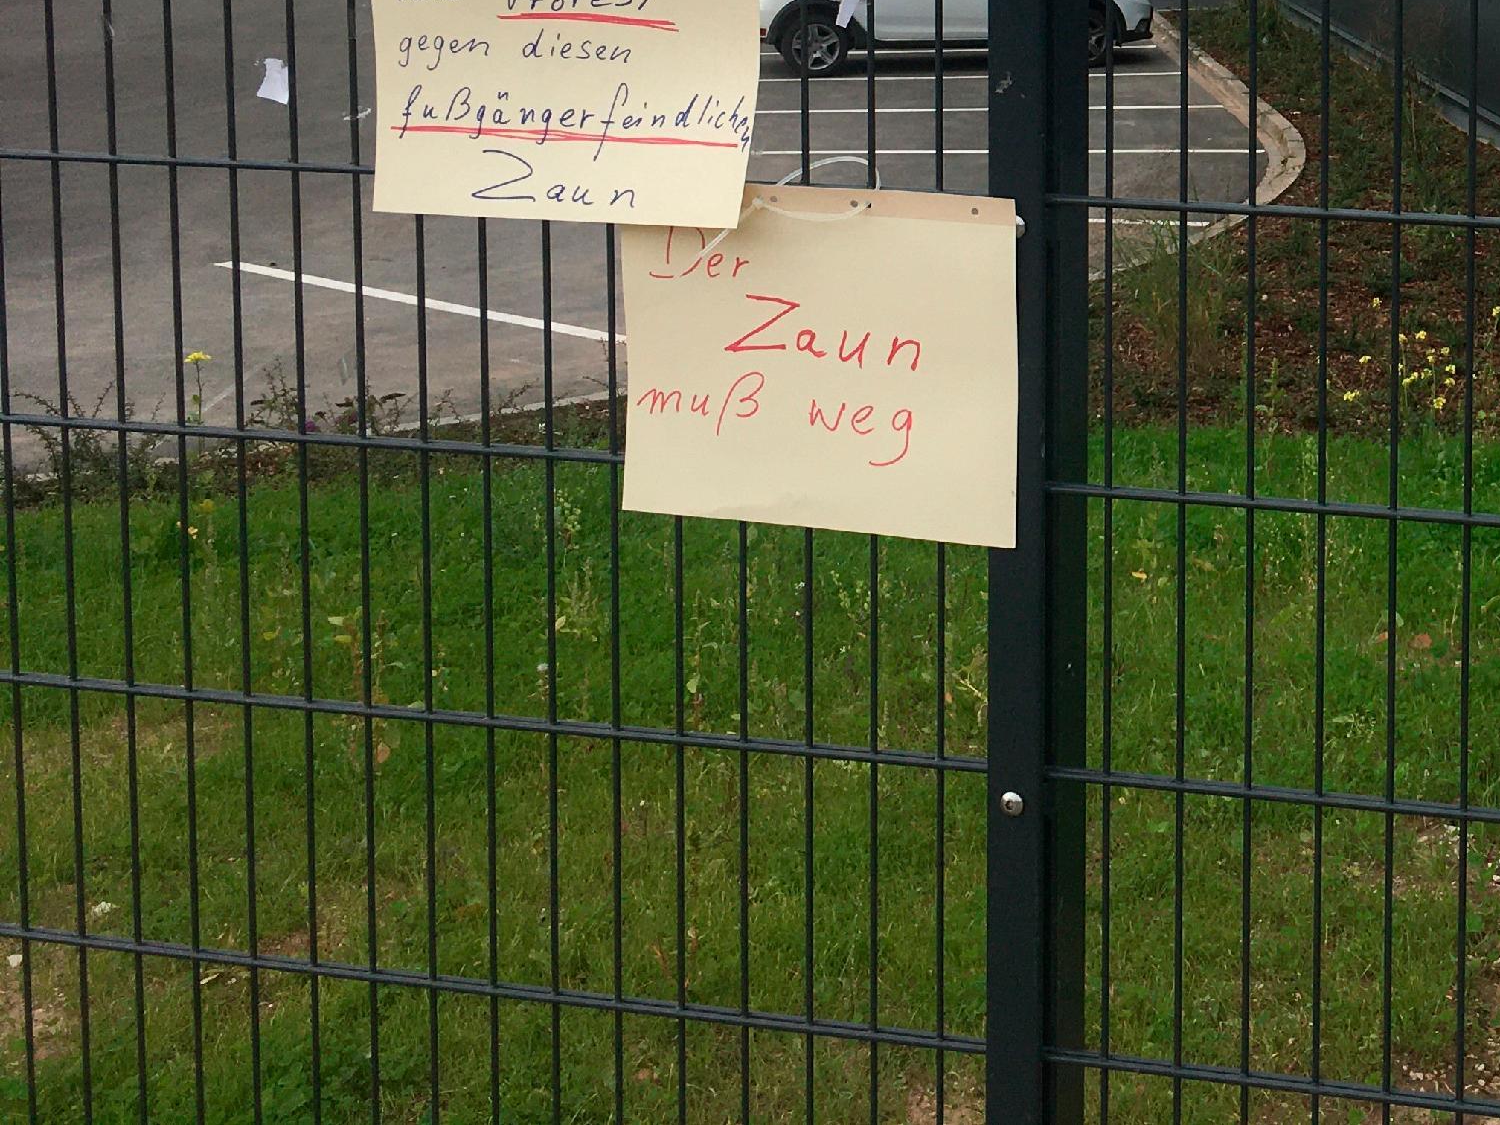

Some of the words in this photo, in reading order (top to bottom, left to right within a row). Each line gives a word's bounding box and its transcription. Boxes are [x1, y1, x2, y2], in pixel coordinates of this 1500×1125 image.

[399, 34, 490, 71] gegen
[522, 28, 633, 64] diesen
[471, 149, 636, 208] Zaun
[649, 227, 750, 278] Der
[724, 294, 921, 371] Zaun
[637, 372, 765, 436] muß
[809, 399, 913, 467] weg
